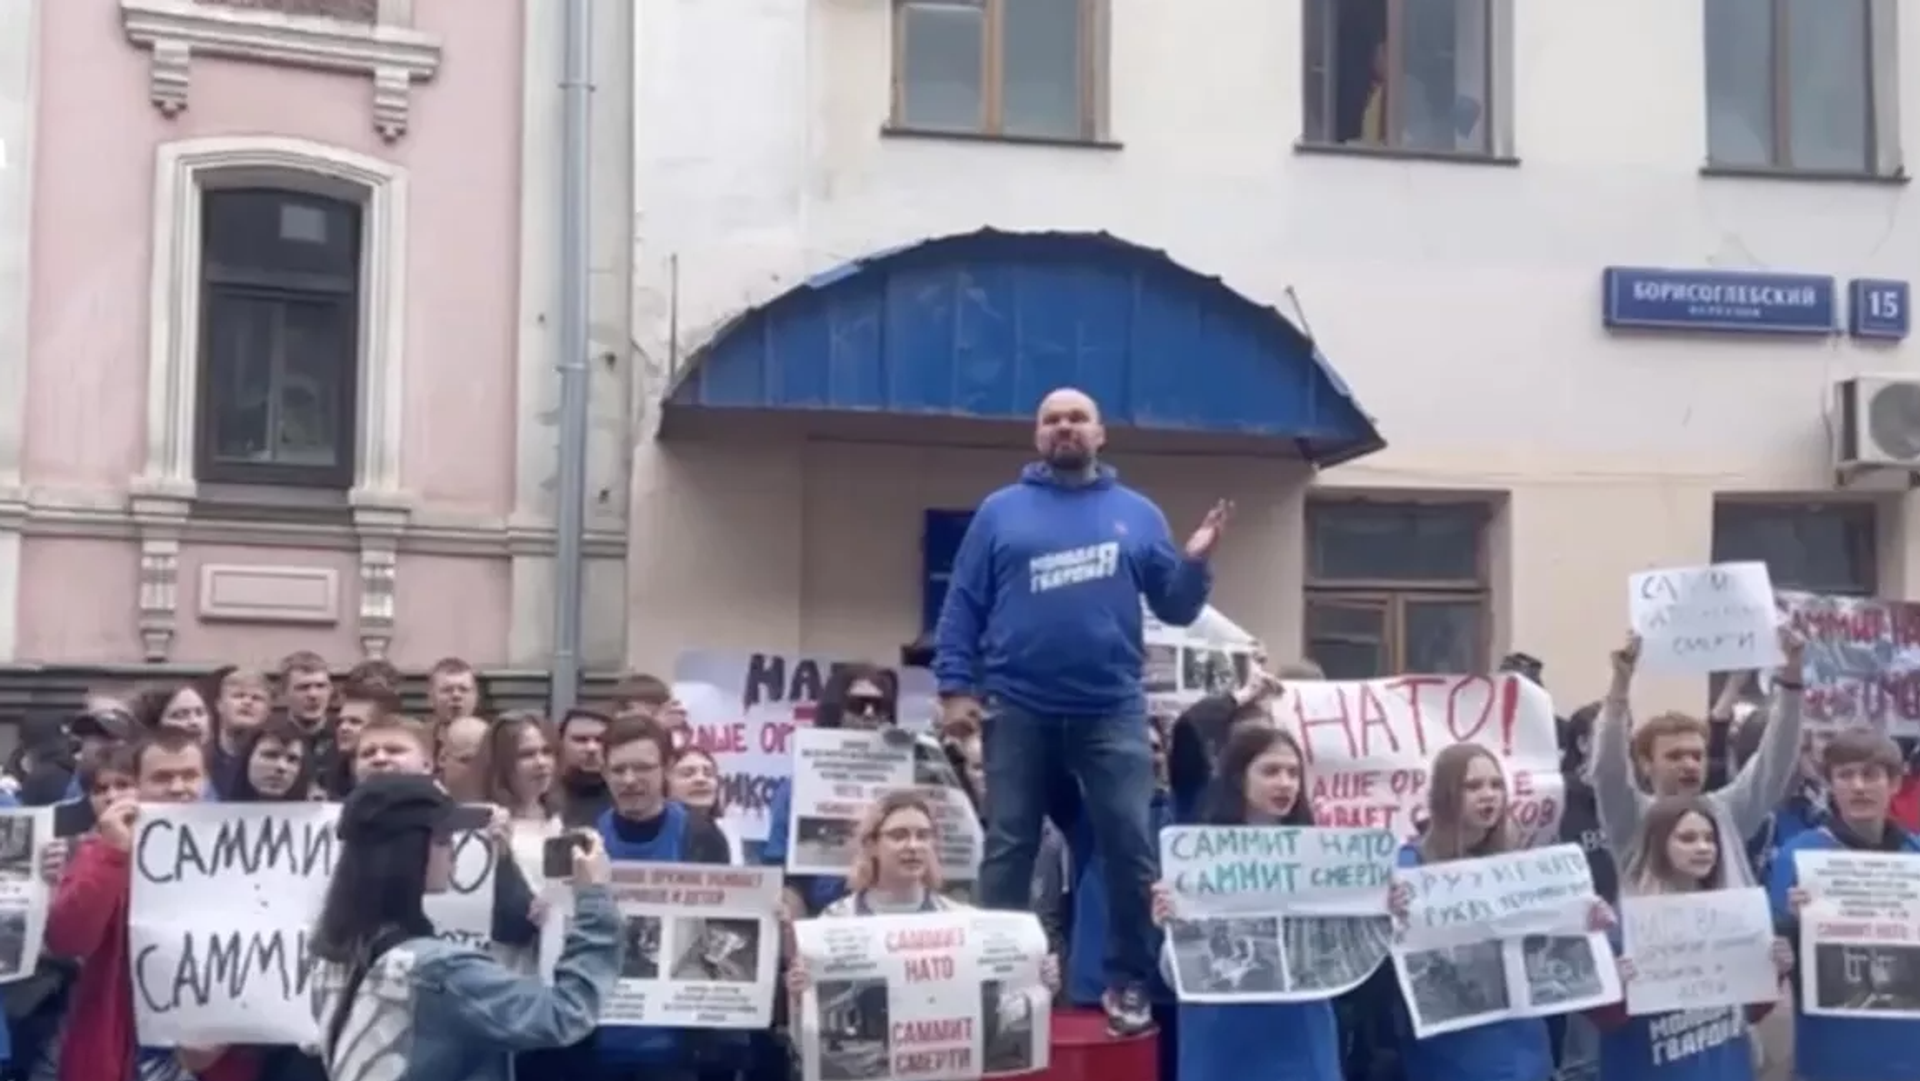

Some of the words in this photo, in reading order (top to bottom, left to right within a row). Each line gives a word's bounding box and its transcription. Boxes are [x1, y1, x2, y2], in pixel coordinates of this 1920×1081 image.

[1632, 280, 1816, 307] БОРИСОГЛЕБСКИЙ
[1868, 290, 1899, 318] 15
[1294, 673, 1519, 764] НАТО!
[1312, 769, 1380, 799] АШЕ
[137, 816, 333, 883] САММИ
[1172, 830, 1301, 860] САММИТ
[1320, 832, 1396, 860] НАТО
[1175, 861, 1301, 894] САММИТ
[1310, 864, 1392, 888] СМЕРТИ
[884, 926, 966, 951] САММИТ
[904, 956, 954, 983] НАТО
[892, 1016, 974, 1045] САММИТ
[894, 1047, 972, 1075] СМЕРТИ
